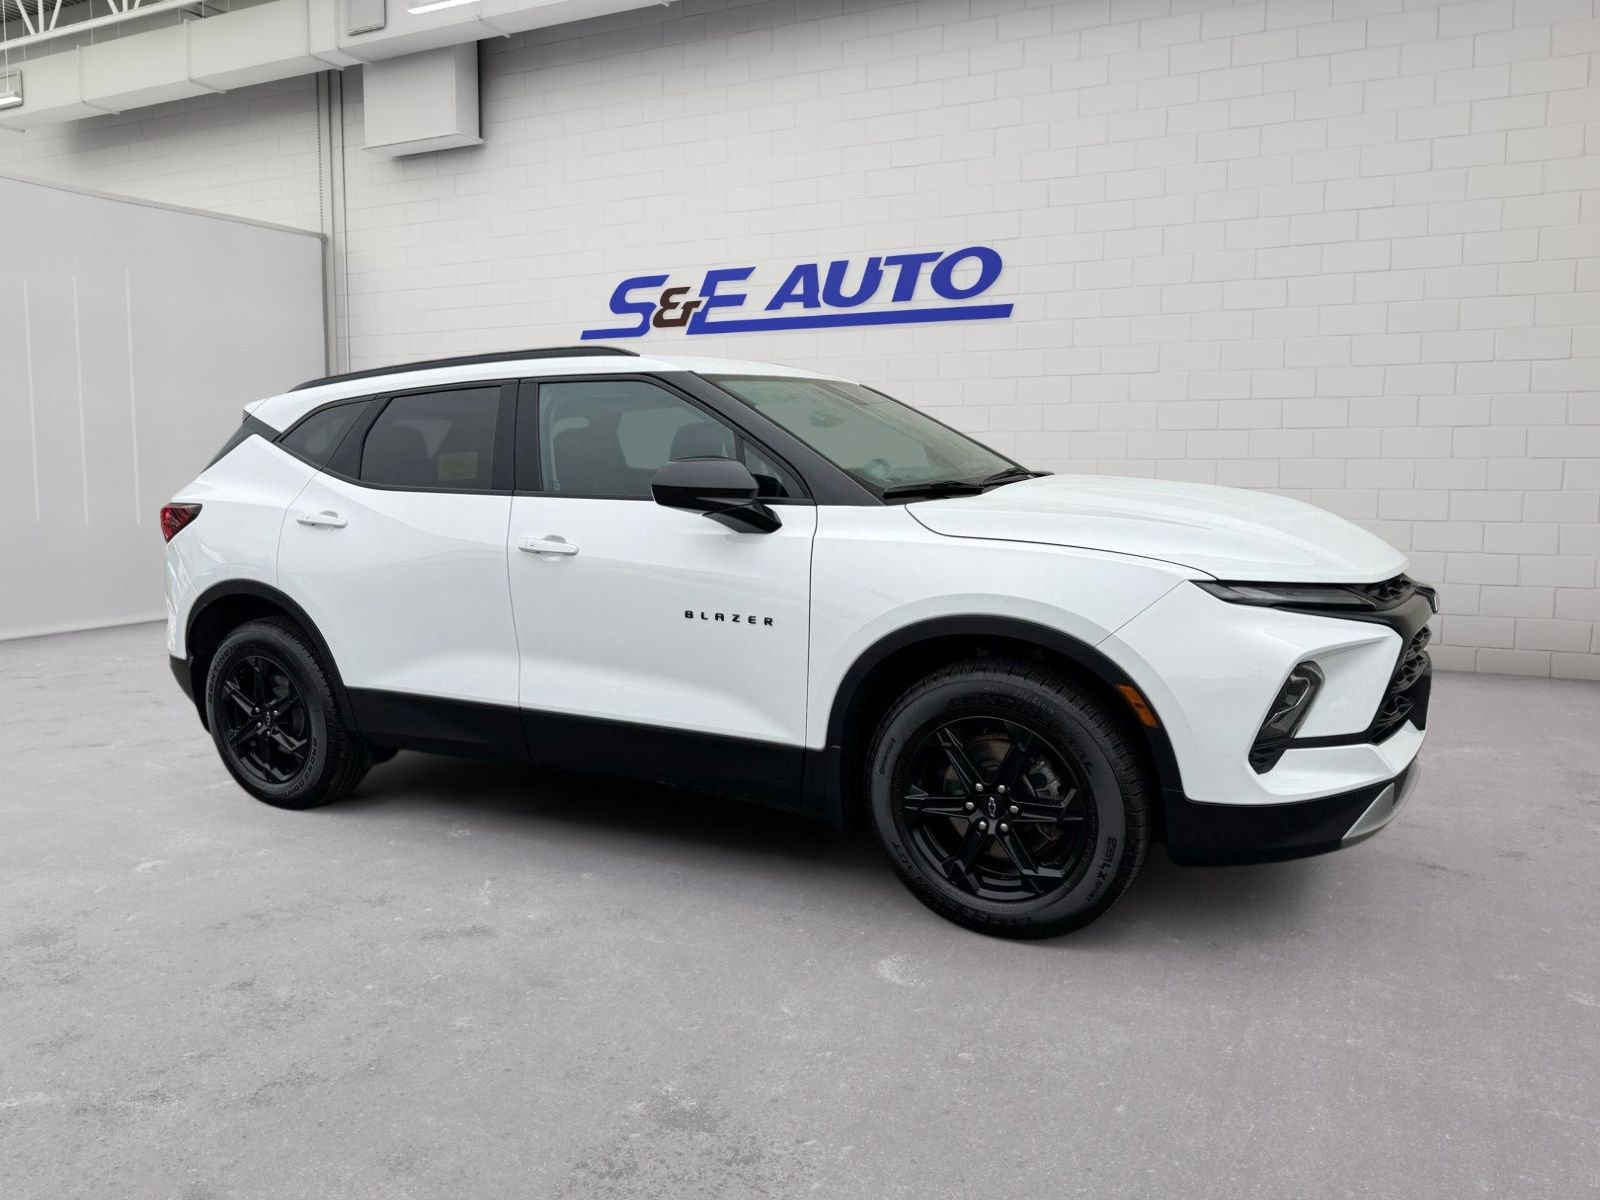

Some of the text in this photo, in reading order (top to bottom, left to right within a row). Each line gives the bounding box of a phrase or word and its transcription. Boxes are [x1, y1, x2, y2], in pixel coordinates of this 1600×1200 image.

[580, 246, 1003, 341] S&E AUTO
[684, 610, 774, 627] BLAZER
